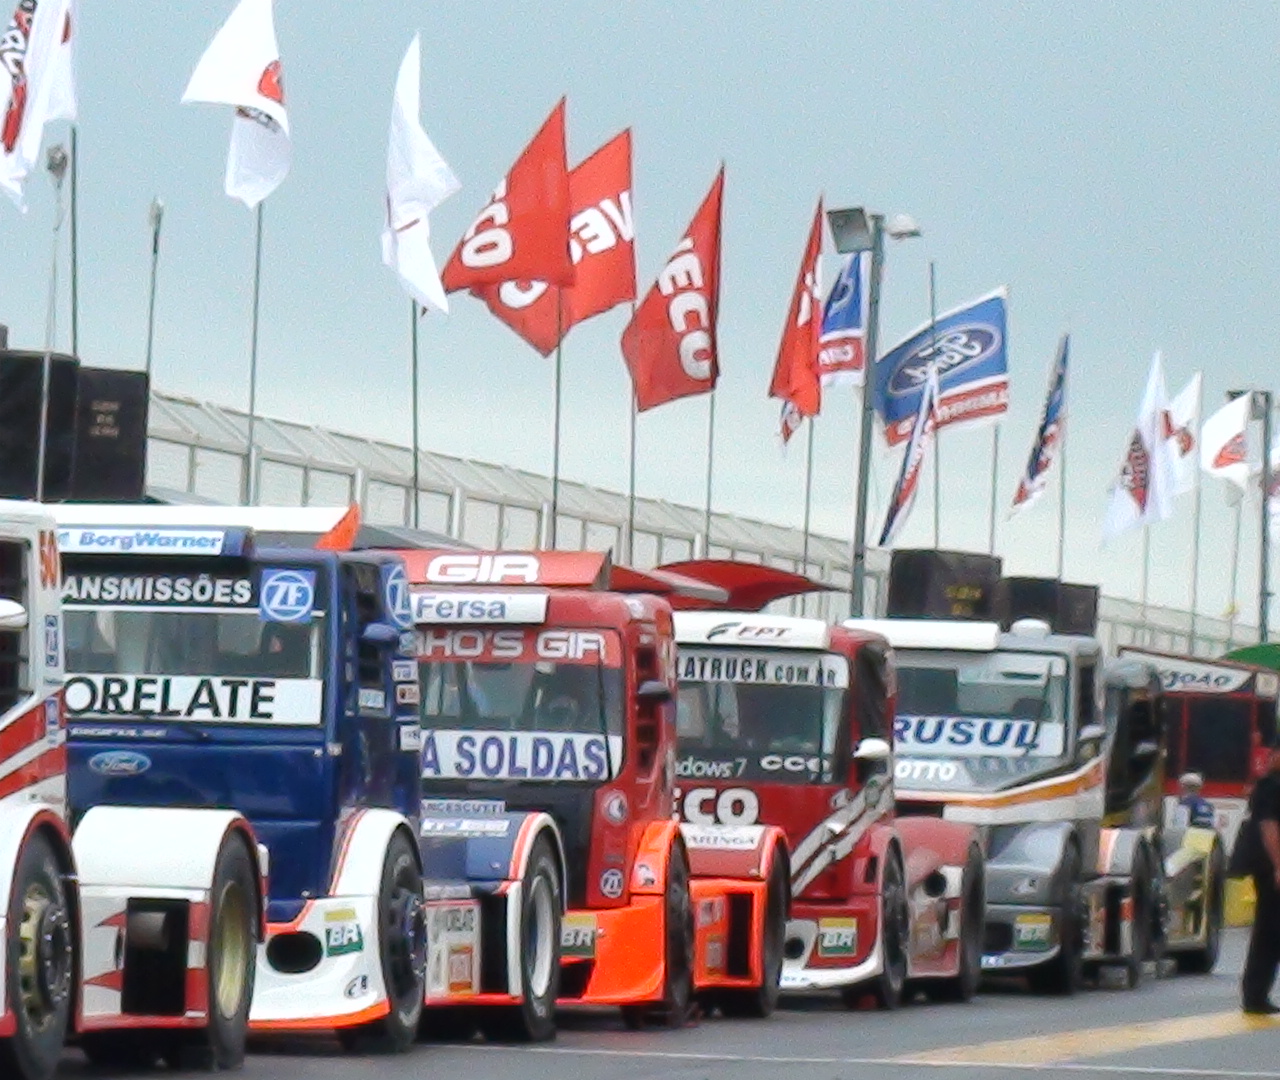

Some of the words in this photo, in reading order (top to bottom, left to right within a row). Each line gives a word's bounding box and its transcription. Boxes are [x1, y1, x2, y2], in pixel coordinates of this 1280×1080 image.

[79, 531, 223, 550] BorgWarner
[426, 554, 540, 583] GIR
[269, 582, 306, 610] ZF
[416, 595, 506, 619] Fersa
[64, 676, 276, 720] ORELATE
[454, 735, 606, 779] SOLDAS
[672, 787, 760, 825] CO
